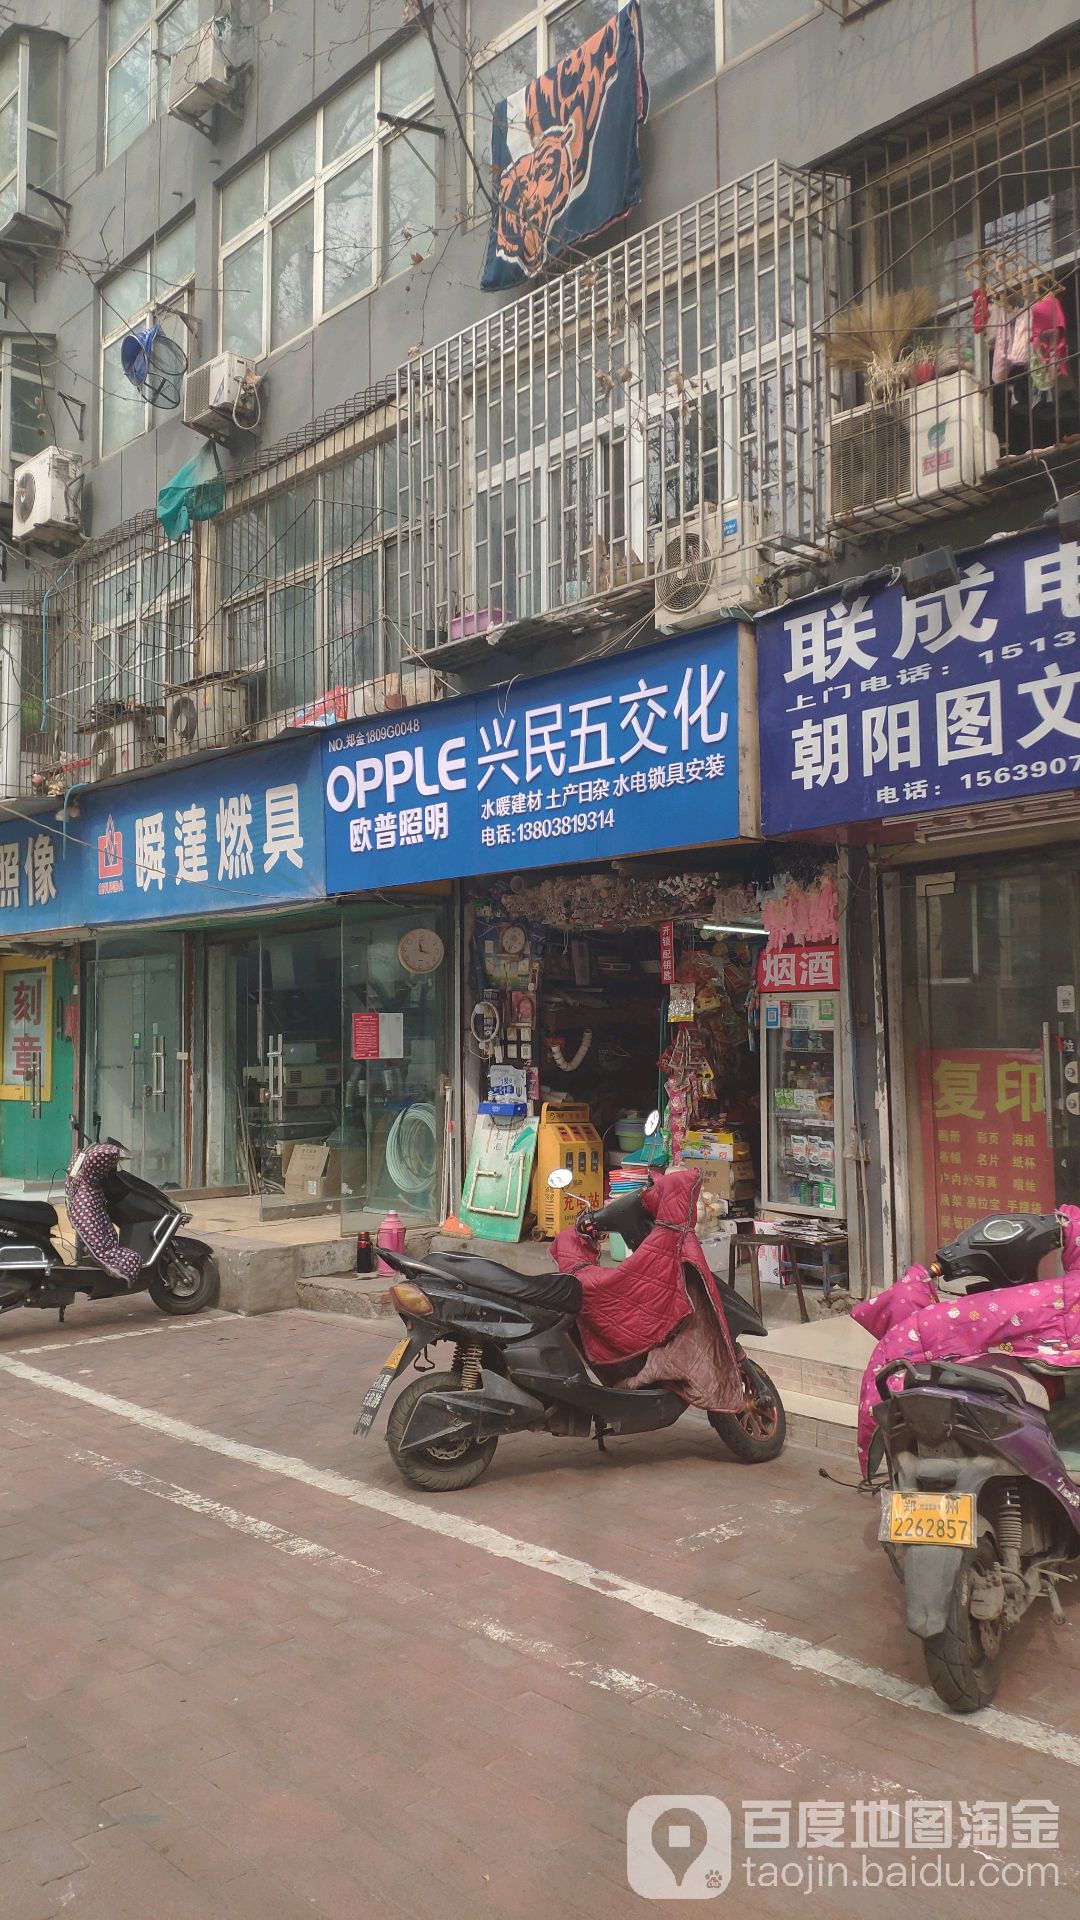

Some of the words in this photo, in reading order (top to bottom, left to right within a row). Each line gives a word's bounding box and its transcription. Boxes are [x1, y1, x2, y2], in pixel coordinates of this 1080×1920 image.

[978, 631, 1077, 665] 1513
[477, 664, 729, 792] 兴民五交化
[791, 663, 1080, 791] 朝阳图文
[327, 737, 467, 812] OPPLE
[481, 789, 543, 820] 水暖建材
[545, 778, 610, 811] 土产日杂
[613, 752, 726, 797] 水电锁具安装
[350, 802, 449, 853] 欧普照明
[481, 808, 615, 847] 电话:13803819314
[763, 950, 834, 987] 烟酒
[12, 978, 42, 1081] 刻章
[932, 1059, 1044, 1122] 复印
[977, 1153, 999, 1168] 名片
[1012, 1155, 1036, 1169] 纸杯
[894, 1517, 968, 1541] 2262857
